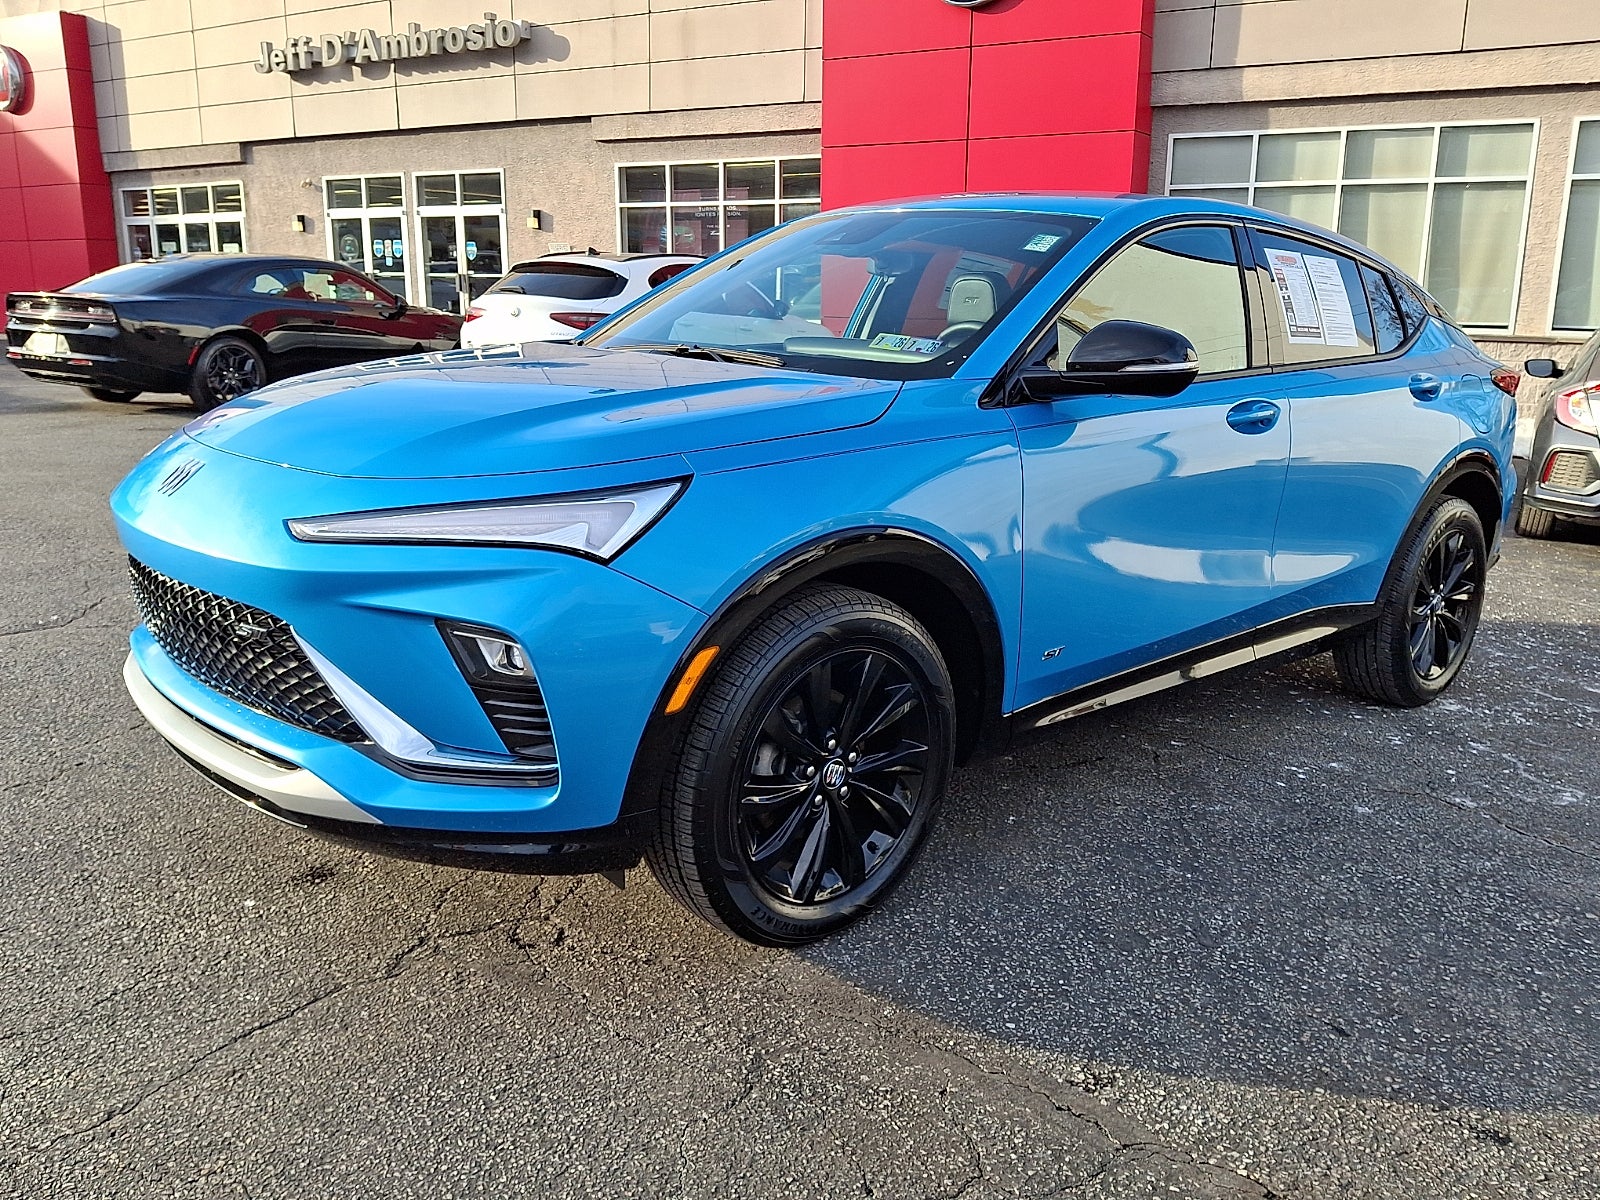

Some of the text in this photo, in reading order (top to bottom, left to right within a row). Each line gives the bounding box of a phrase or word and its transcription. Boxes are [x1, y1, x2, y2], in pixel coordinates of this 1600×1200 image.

[254, 12, 521, 73] Jeff D'Ambrosio
[963, 296, 980, 305] ST
[1041, 644, 1066, 661] ST
